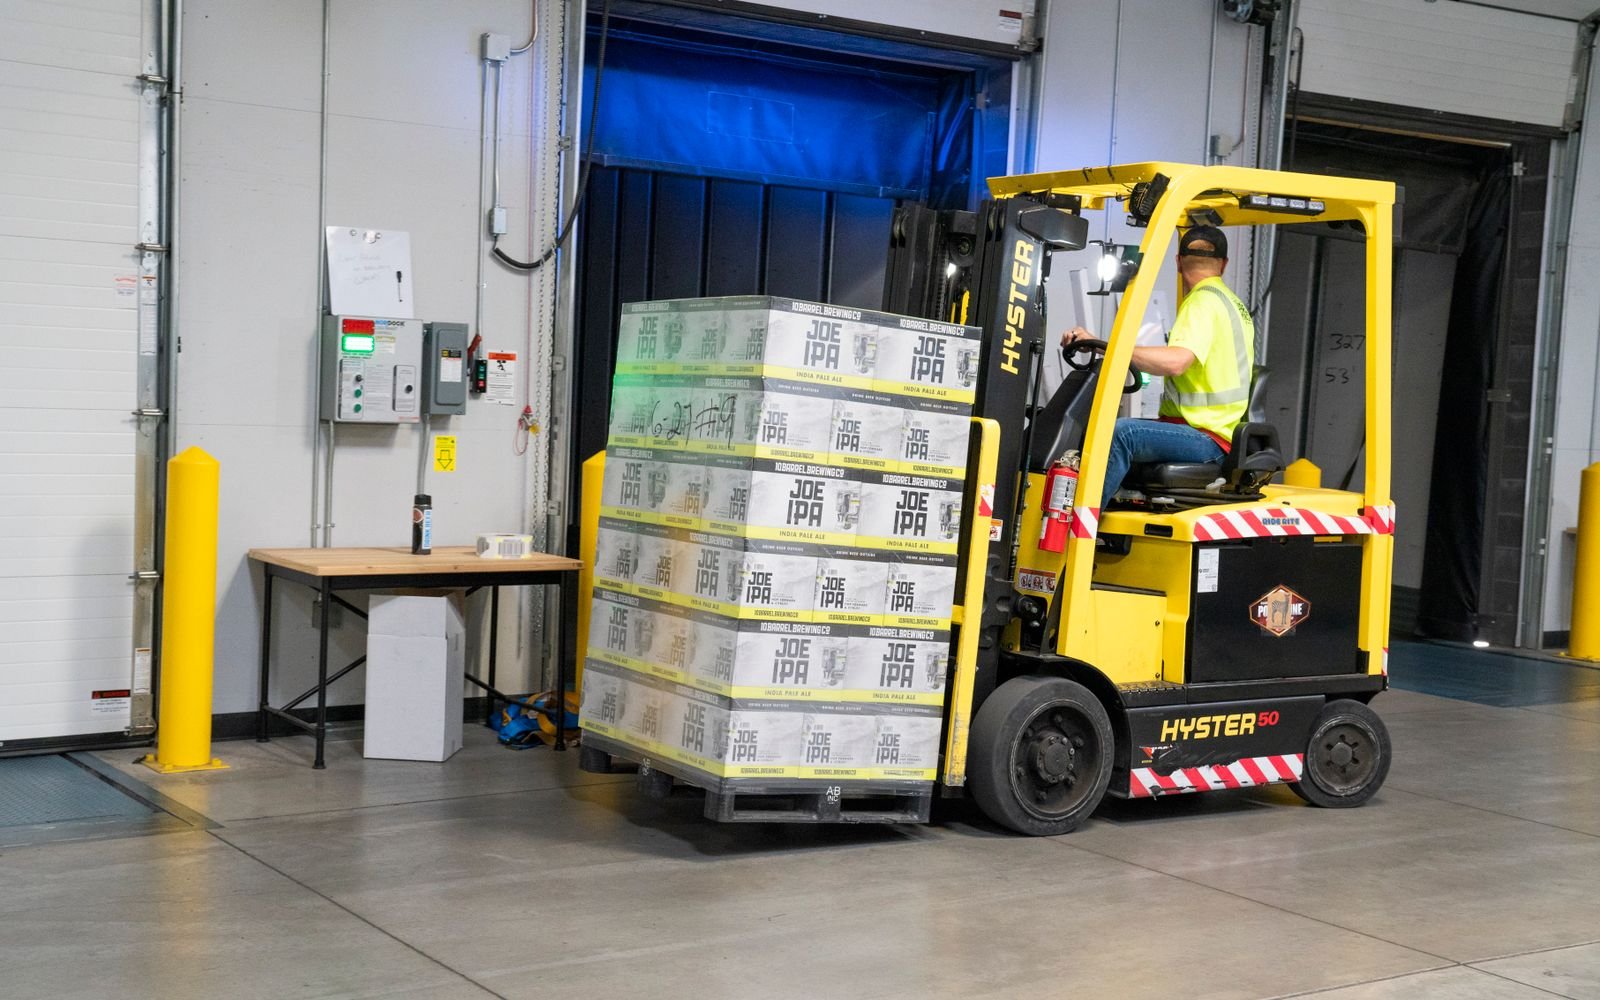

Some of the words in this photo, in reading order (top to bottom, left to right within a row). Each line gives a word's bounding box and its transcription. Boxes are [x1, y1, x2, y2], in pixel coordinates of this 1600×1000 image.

[1001, 240, 1034, 375] HYSTER
[639, 317, 658, 335] JOE
[747, 328, 764, 341] JOE
[806, 320, 842, 343] JOE
[636, 336, 656, 359] IPA
[914, 336, 946, 358] JOE
[1330, 334, 1366, 350] 327
[745, 343, 762, 360] IPA
[804, 342, 840, 369] IPA
[910, 356, 944, 383] IPA
[764, 411, 788, 426] JOE
[838, 419, 861, 434] JOE
[762, 426, 786, 445] IPA
[835, 433, 860, 453] IPA
[907, 429, 930, 442] JOE
[905, 442, 928, 460] IPA
[622, 462, 641, 481] JOE
[620, 481, 640, 506] IPA
[686, 483, 701, 496] JOE
[730, 488, 747, 502] JOE
[790, 480, 825, 500] JOE
[684, 495, 699, 514] IPA
[896, 491, 929, 511] JOE
[729, 502, 745, 520] IPA
[787, 500, 823, 527] IPA
[893, 511, 927, 536] IPA
[1282, 517, 1300, 525] RITE
[617, 548, 631, 562] JOE
[657, 556, 672, 570] JOE
[698, 549, 720, 571] JOE
[616, 562, 629, 578] IPA
[656, 569, 670, 587] IPA
[748, 572, 772, 586] JOE
[695, 569, 718, 597] IPA
[822, 577, 846, 591] JOE
[893, 581, 915, 595] JOE
[746, 586, 771, 604] IPA
[820, 591, 844, 609] IPA
[890, 595, 913, 612] IPA
[609, 606, 628, 627] JOE
[607, 625, 626, 652] IPA
[776, 638, 811, 659] JOE
[883, 643, 916, 663] JOE
[772, 659, 809, 684] IPA
[880, 663, 914, 688] IPA
[684, 703, 706, 726] JOE
[1160, 713, 1256, 742] HYSTER
[1258, 711, 1279, 726] 50
[682, 723, 704, 752] IPA
[734, 730, 758, 743] JOE
[808, 732, 832, 745] JOE
[878, 734, 900, 747] JOE
[732, 745, 756, 761] IPA
[806, 747, 830, 763] IPA
[876, 748, 899, 764] IPA
[826, 786, 840, 795] AB
